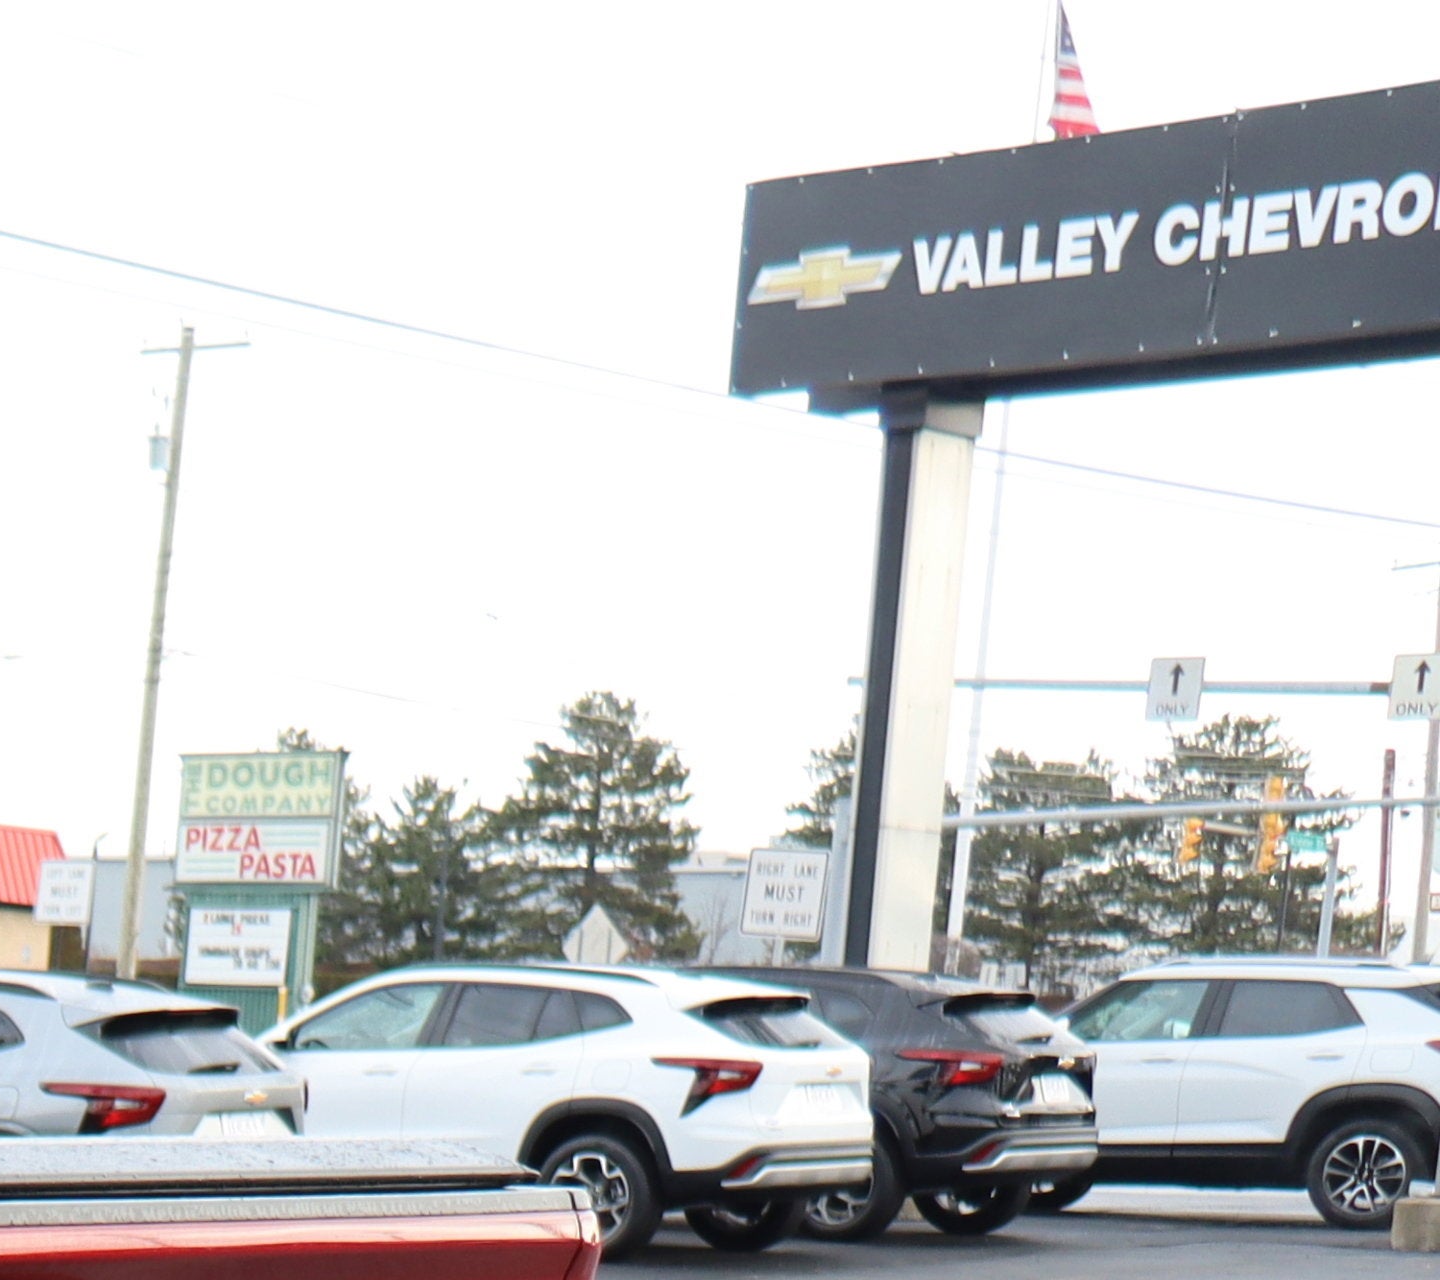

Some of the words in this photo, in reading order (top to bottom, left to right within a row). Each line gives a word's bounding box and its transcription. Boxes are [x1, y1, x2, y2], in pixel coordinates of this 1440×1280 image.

[913, 211, 1140, 295] VALLEY
[1153, 171, 1440, 267] CHEVRO
[1155, 703, 1190, 717] ONLY
[1395, 702, 1439, 717] ONLY
[206, 760, 330, 789] DOUGH
[205, 793, 329, 814] COMPANY
[185, 825, 261, 852] PIZZA
[239, 853, 316, 880] PASTA
[756, 862, 785, 877] RIGHT
[794, 863, 819, 879] LANE
[764, 883, 804, 902] MUST
[750, 909, 775, 925] TURN
[783, 911, 812, 927] RIGHT
